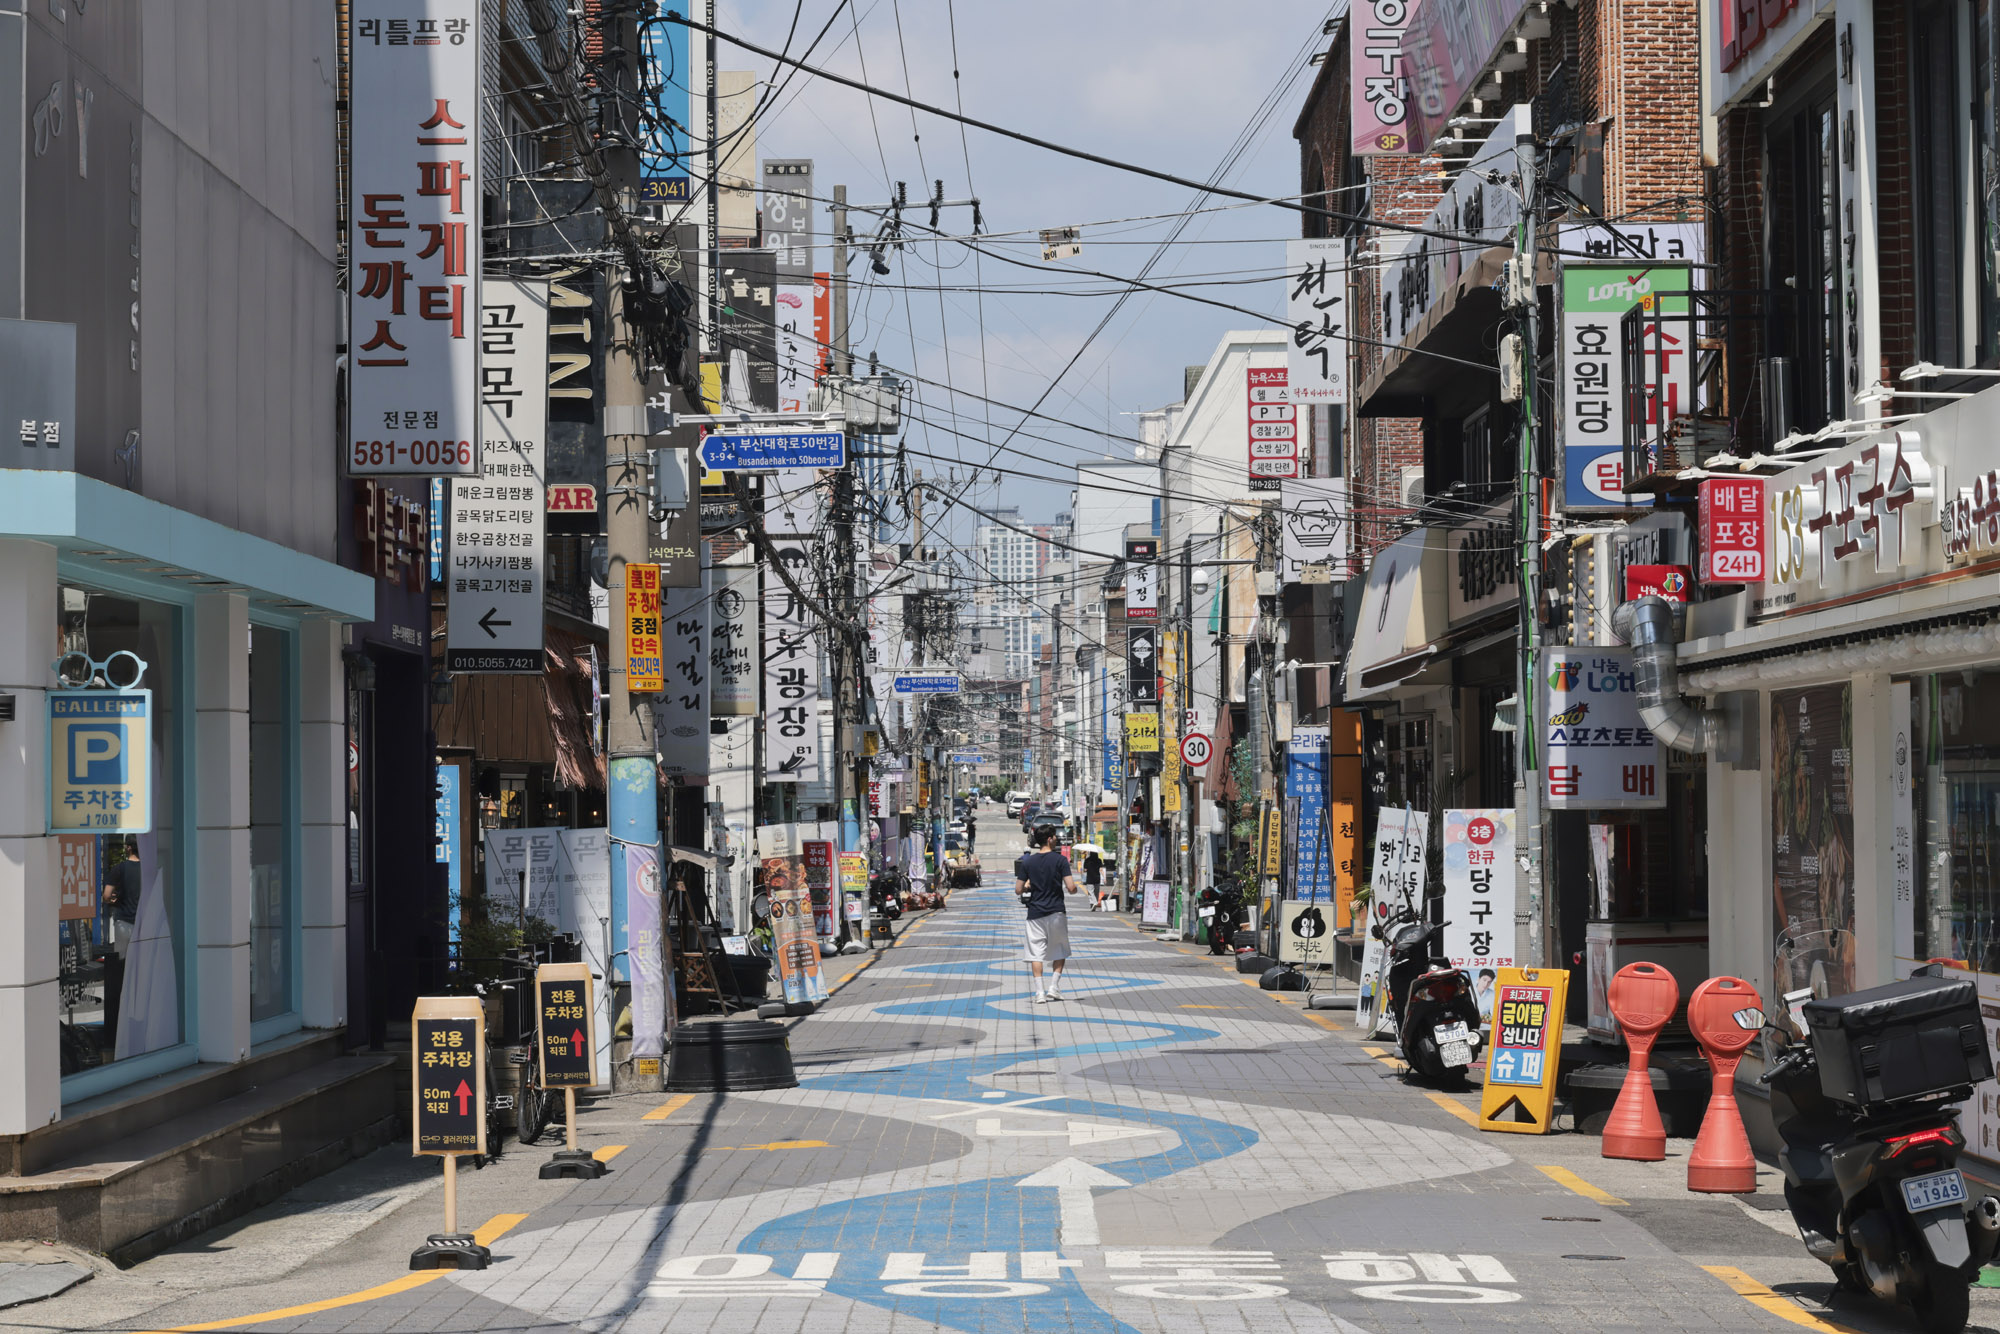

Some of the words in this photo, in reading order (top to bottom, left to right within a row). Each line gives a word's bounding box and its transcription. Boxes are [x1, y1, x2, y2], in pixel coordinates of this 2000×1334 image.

[358, 18, 470, 46] 리틀프랑
[1380, 135, 1398, 149] 3F
[417, 99, 471, 339] 스파게티
[357, 194, 414, 367] 돈까스
[1588, 277, 1651, 302] LOTTO
[1573, 324, 1612, 433] 효원당
[383, 411, 438, 430] 전문점
[1256, 426, 1272, 437] 경찰
[1274, 425, 1290, 436] 실기
[484, 440, 535, 454] 치즈새우
[722, 442, 736, 452] 3-1
[739, 437, 840, 452] 부산대학로50번길
[1256, 444, 1272, 455] 소방
[1274, 443, 1290, 455] 실기
[353, 440, 471, 466] 581-0056
[709, 452, 726, 462] 3-9
[738, 456, 797, 467] Busandaehak-ro
[798, 454, 840, 466] 50beon-gil
[484, 463, 535, 477] 대패한판
[1256, 463, 1272, 474] 체력
[1274, 462, 1290, 474] 단련
[457, 486, 534, 501] 매운크림짬뽕
[548, 488, 595, 510] AR
[1714, 487, 1760, 513] 배달
[456, 509, 534, 524] 골목닭도리탕
[456, 532, 534, 547] 한우곱창전골
[1714, 521, 1760, 547] 포장
[456, 555, 534, 570] 나가사키짬뽕
[1717, 555, 1757, 574] 24H
[455, 579, 533, 594] 골목고기전골
[631, 569, 657, 589] 불법
[631, 617, 657, 635] 중점
[631, 637, 658, 655] 단속
[454, 657, 534, 670] 010.5055.7421
[629, 657, 660, 676] 견인지역
[1587, 672, 1636, 693] Lott
[54, 700, 140, 713] GALLERY
[1290, 734, 1326, 748] 우리집
[1547, 727, 1654, 748] 스포츠토토
[75, 731, 122, 778] P
[796, 746, 812, 755] B1
[1187, 742, 1206, 758] 30
[1548, 764, 1583, 796] 담
[1622, 764, 1655, 796] 배
[64, 789, 133, 811] 주차장
[95, 812, 117, 826] 70M
[1270, 813, 1280, 864] 무단투기단속
[1470, 825, 1492, 839] 3층
[1467, 850, 1495, 865] 한큐
[1469, 868, 1493, 956] 당구장
[1474, 957, 1488, 968] 3구
[1497, 956, 1513, 968] 포켓
[551, 989, 577, 1004] 전용
[1509, 989, 1543, 1001] 최고가로
[544, 1005, 584, 1020] 주차장
[1501, 1002, 1546, 1027] 금이빨
[431, 1030, 464, 1048] 전용
[547, 1035, 568, 1045] 50m
[1502, 1027, 1541, 1047] 삽니다
[550, 1045, 568, 1056] 직진
[422, 1051, 473, 1068] 주차장
[1496, 1052, 1541, 1081] 슈퍼
[423, 1088, 451, 1099] 50m
[426, 1102, 449, 1114] 직진
[442, 1135, 477, 1144] 갤러리안경
[1923, 1183, 1960, 1203] 1949
[636, 1250, 1523, 1304] 일방통행
